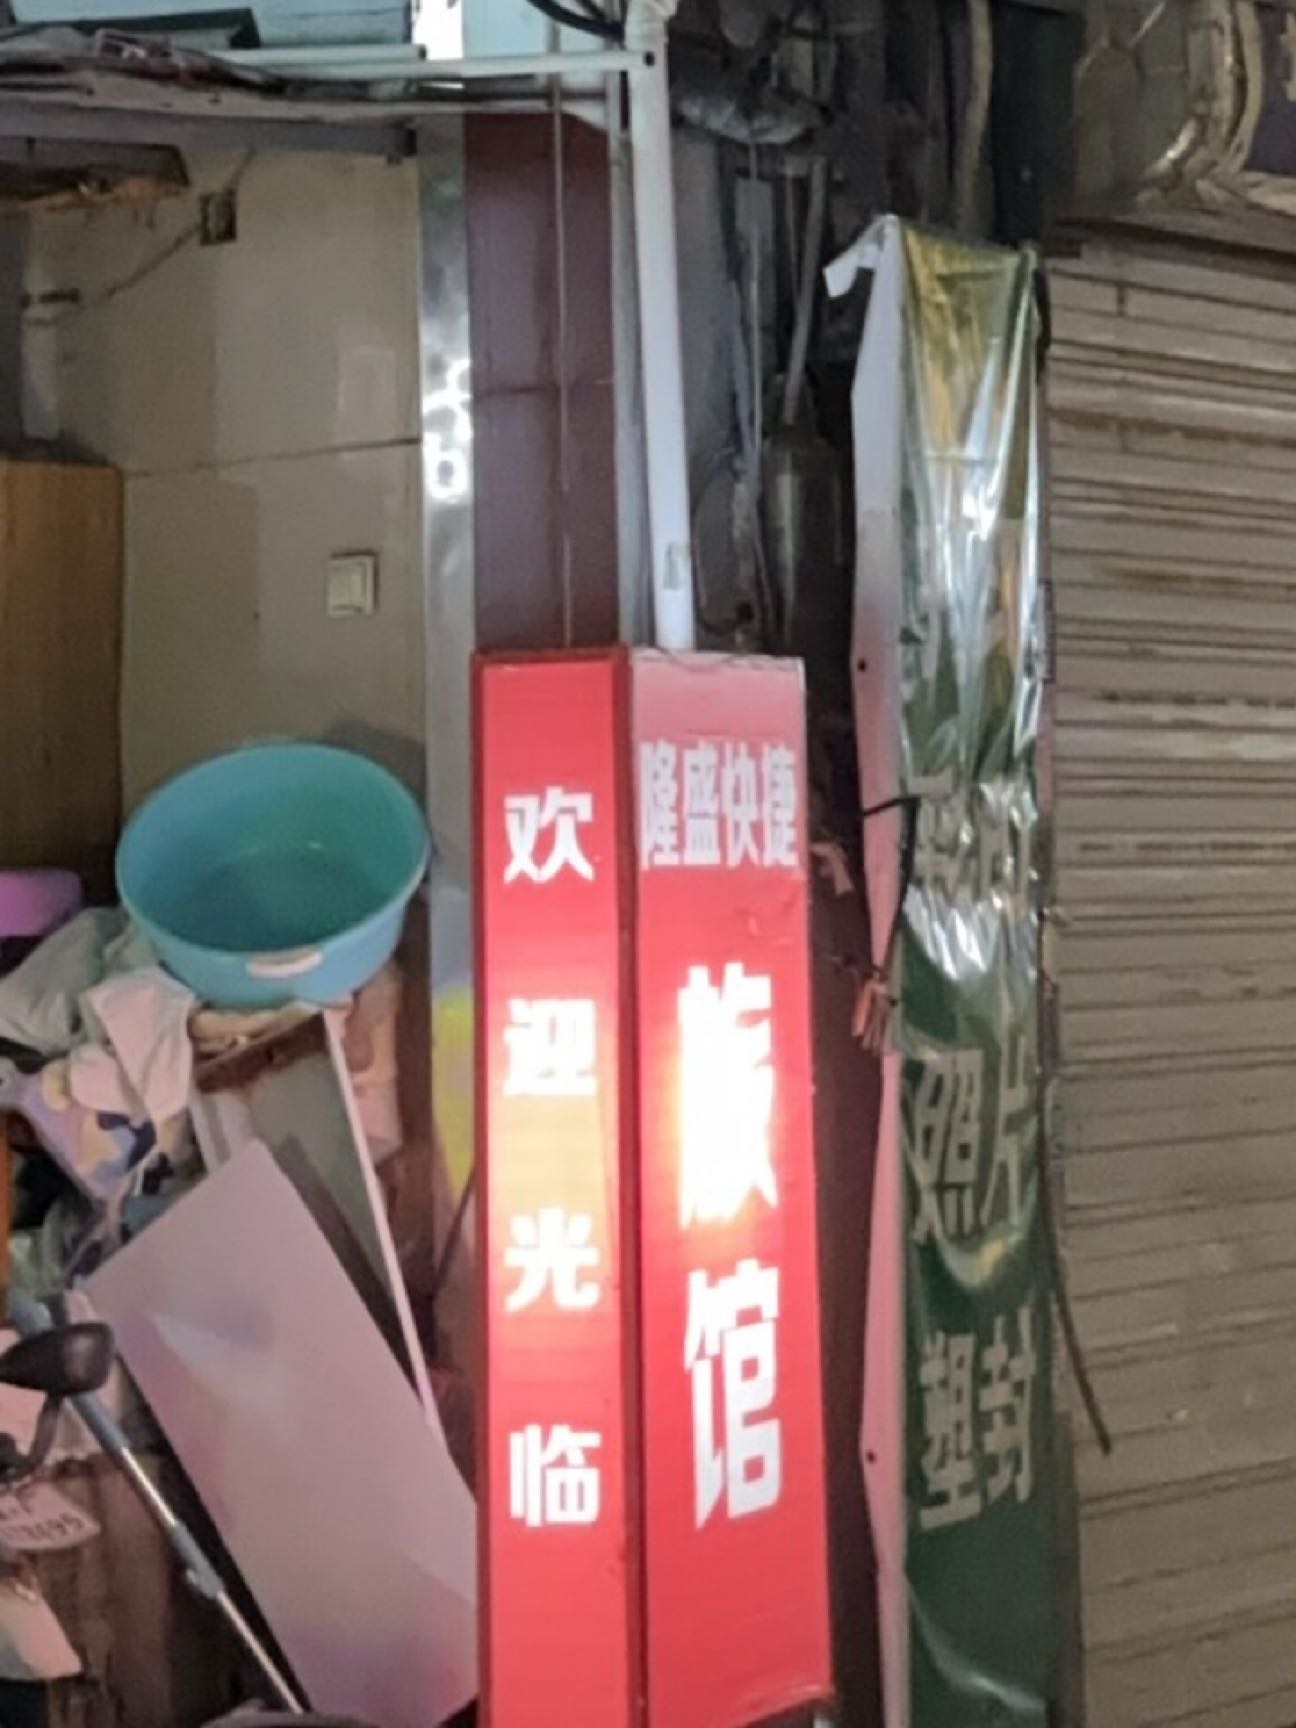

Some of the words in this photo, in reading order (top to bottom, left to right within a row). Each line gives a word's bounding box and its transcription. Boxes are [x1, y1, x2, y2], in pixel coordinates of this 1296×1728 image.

[640, 739, 799, 870] 隆盛快捷
[503, 785, 602, 1528] 欢迎光临
[911, 1034, 1031, 1240] 照片
[918, 1302, 1037, 1532] 塑封
